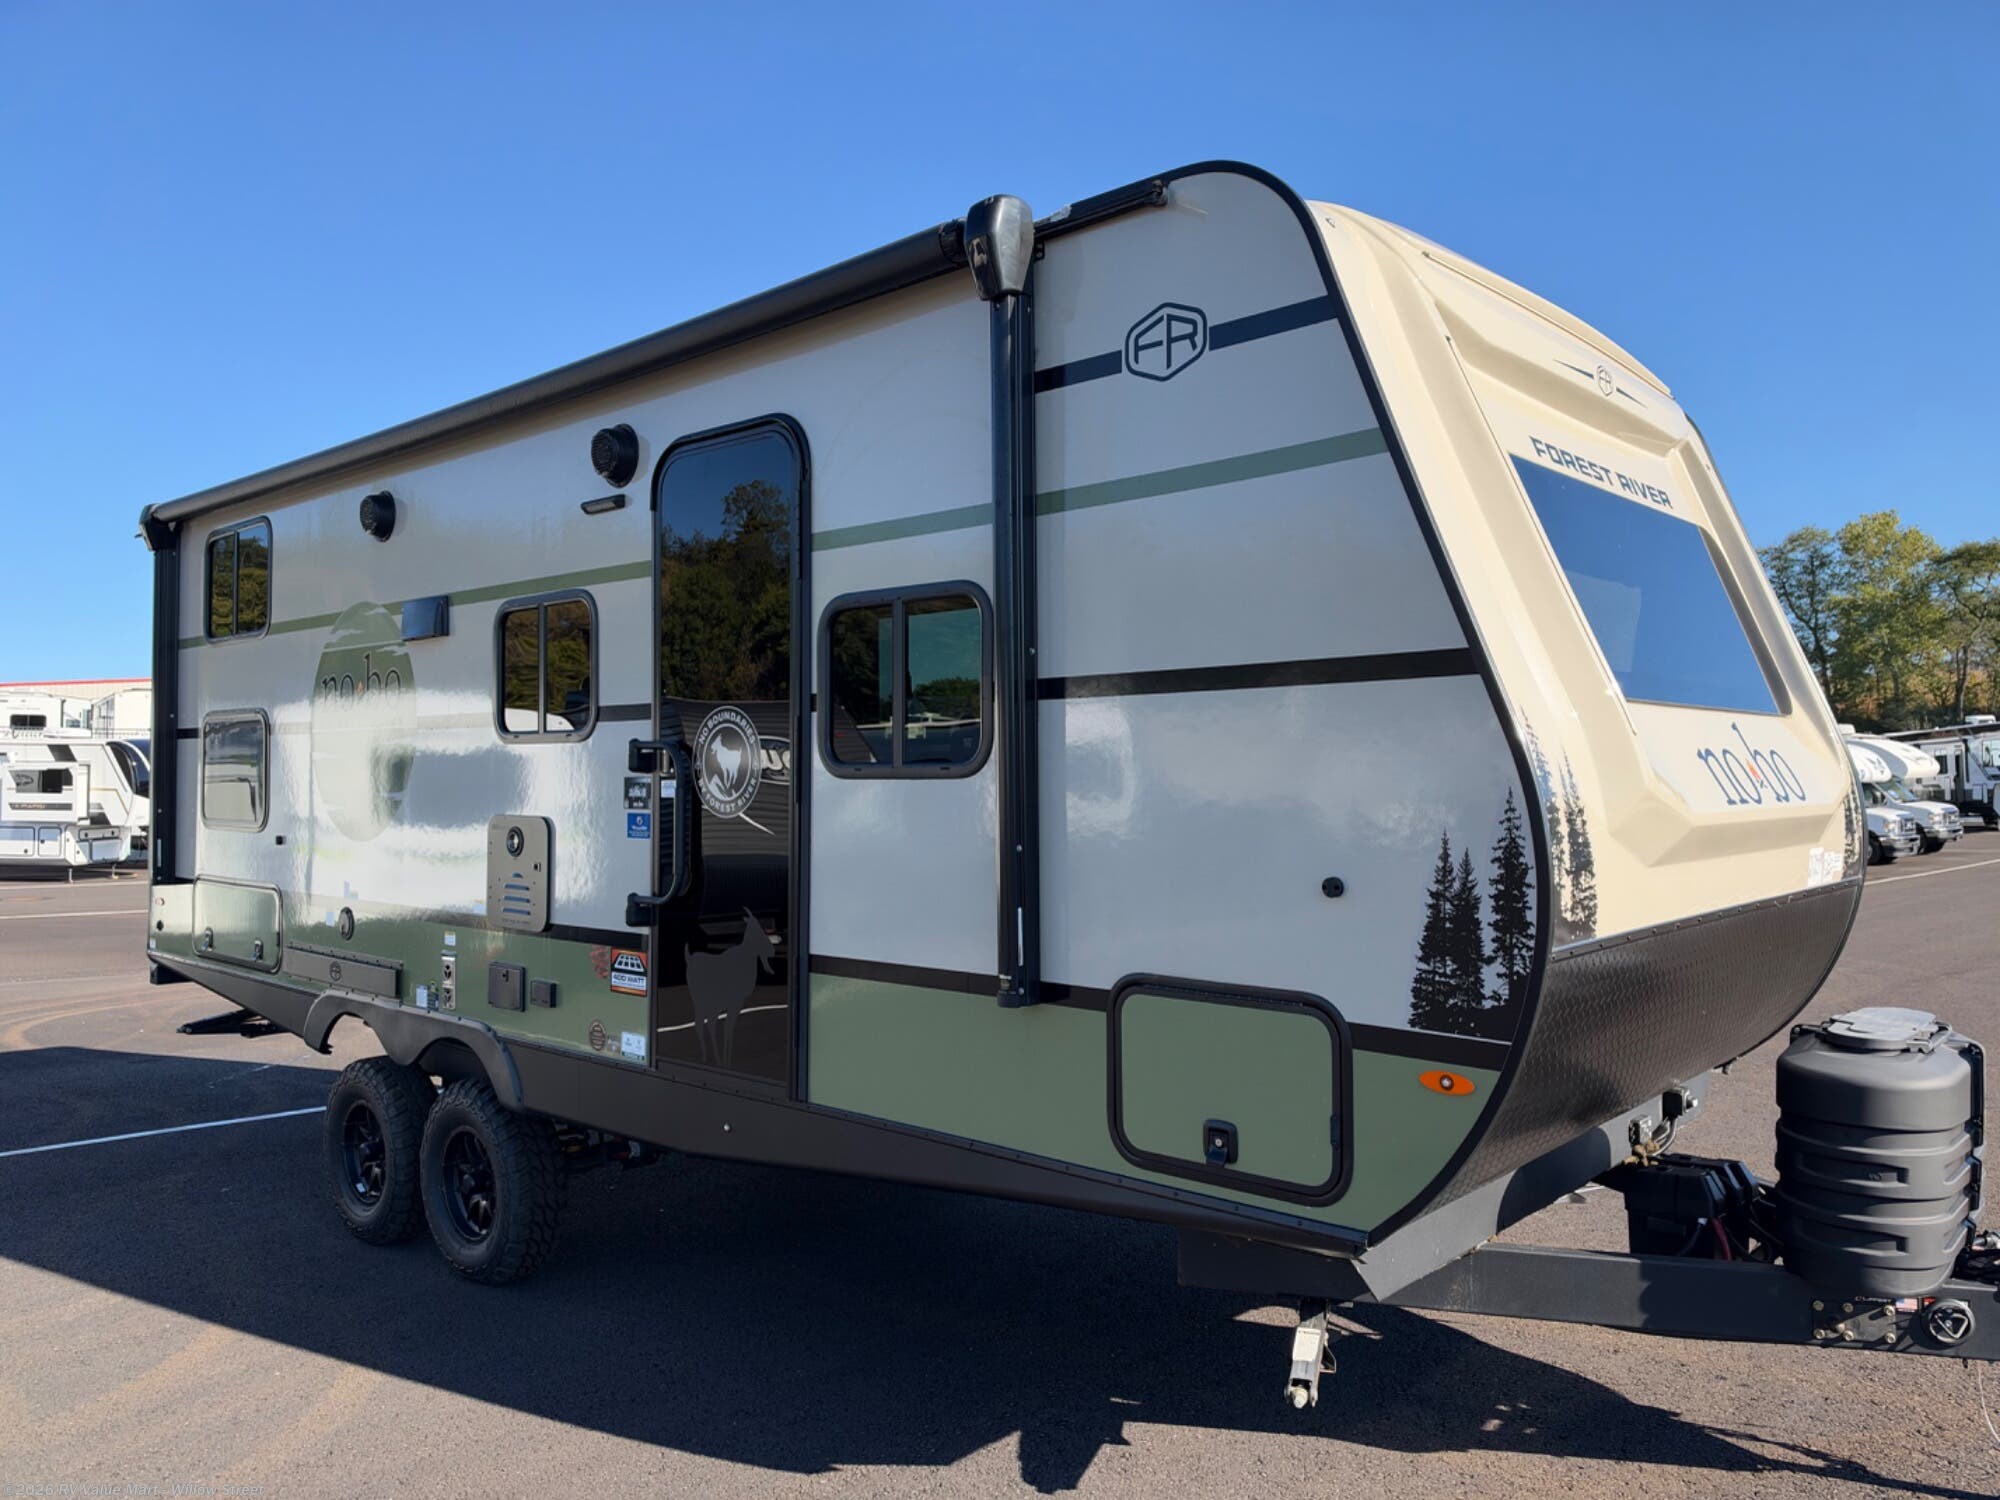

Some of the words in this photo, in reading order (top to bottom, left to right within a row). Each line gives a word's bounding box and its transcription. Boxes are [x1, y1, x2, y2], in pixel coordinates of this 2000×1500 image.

[1133, 312, 1199, 370] FR
[1528, 435, 1614, 486] FOREST
[1615, 471, 1674, 509] RIVER
[698, 727, 709, 745] NO
[706, 711, 756, 744] BOUNDARIES
[704, 793, 737, 813] FOREST
[736, 778, 757, 807] RIVER
